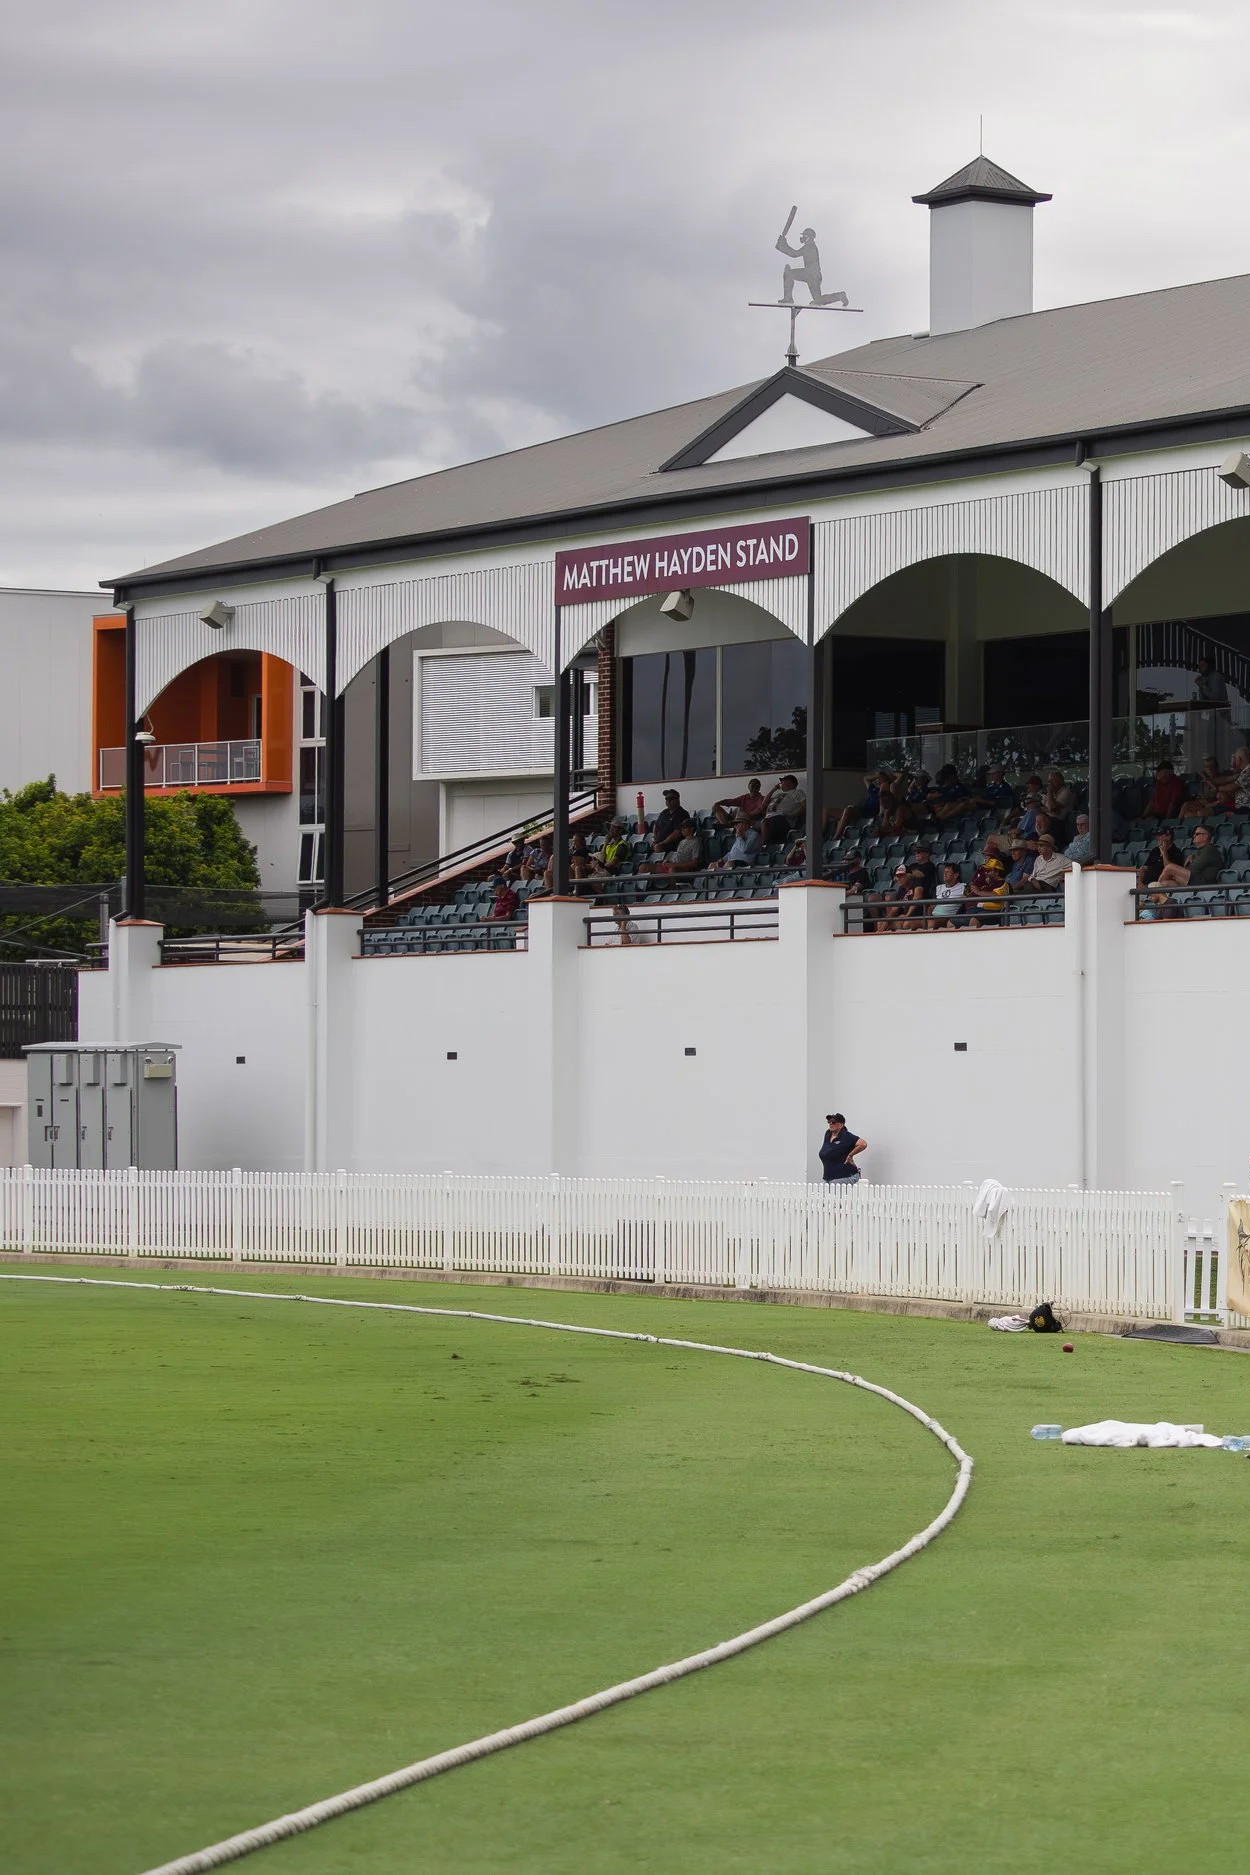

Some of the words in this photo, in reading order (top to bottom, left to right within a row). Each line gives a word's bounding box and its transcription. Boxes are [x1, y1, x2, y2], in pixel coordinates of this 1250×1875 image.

[563, 553, 650, 590] MATTHEW
[655, 542, 731, 578] HAYDEN
[736, 533, 799, 567] STAND
